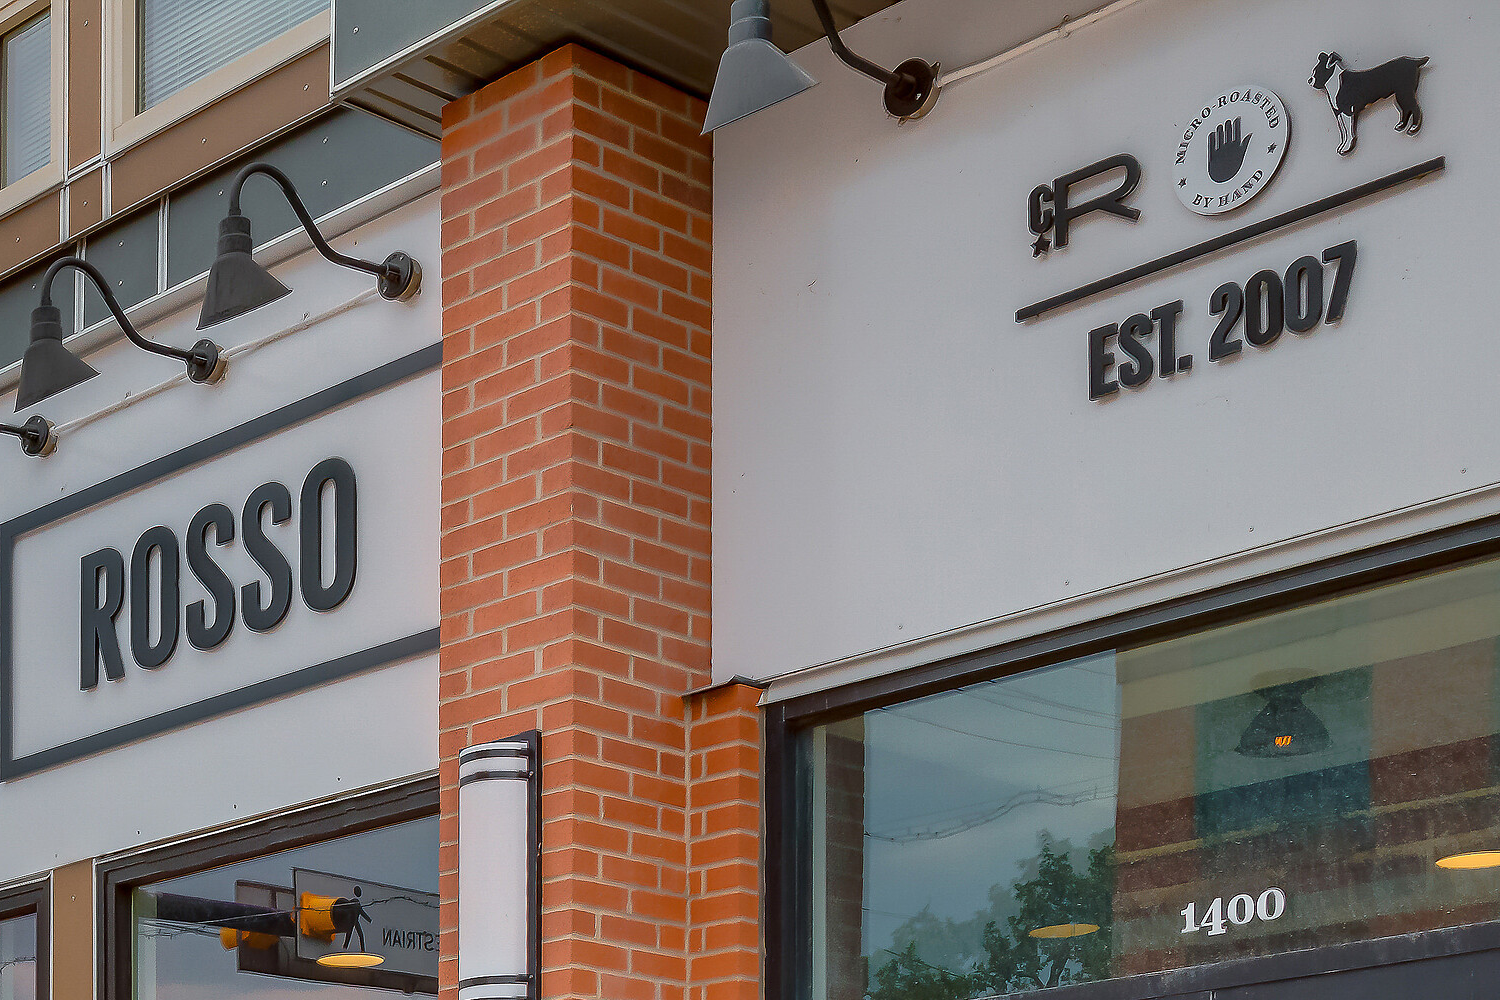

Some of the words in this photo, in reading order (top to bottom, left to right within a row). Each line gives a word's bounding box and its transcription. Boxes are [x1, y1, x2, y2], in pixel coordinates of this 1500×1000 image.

[1174, 88, 1280, 165] MICRO-ROASTED
[1191, 193, 1214, 208] BY
[1217, 169, 1264, 208] HAND
[1088, 299, 1193, 401] EST.
[1208, 240, 1358, 362] 2007
[80, 457, 358, 692] ROSSO
[1180, 887, 1287, 937] 1400
